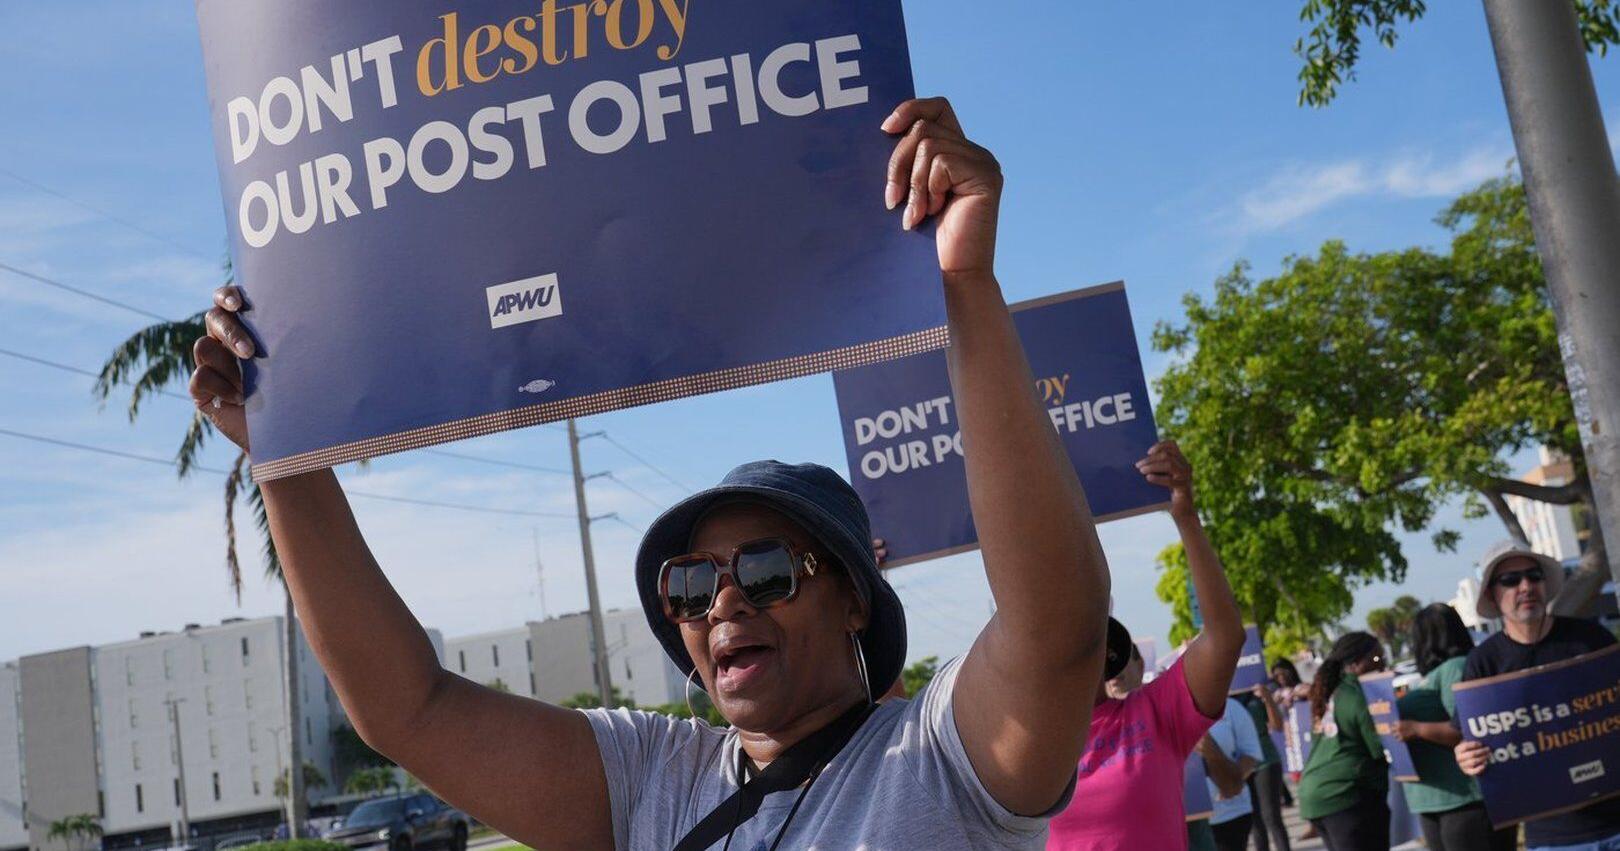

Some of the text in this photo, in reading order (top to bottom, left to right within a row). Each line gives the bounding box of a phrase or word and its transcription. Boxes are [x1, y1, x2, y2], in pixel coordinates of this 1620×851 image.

[227, 0, 689, 165] DON'T destroy
[239, 34, 869, 248] OUR POST OFFICE
[492, 285, 555, 318] APWU
[854, 396, 951, 446] DON'T
[860, 440, 932, 480] OUR
[1047, 391, 1136, 436] FFICE
[1467, 679, 1620, 738] USPS is a serv
[1521, 741, 1537, 756] a
